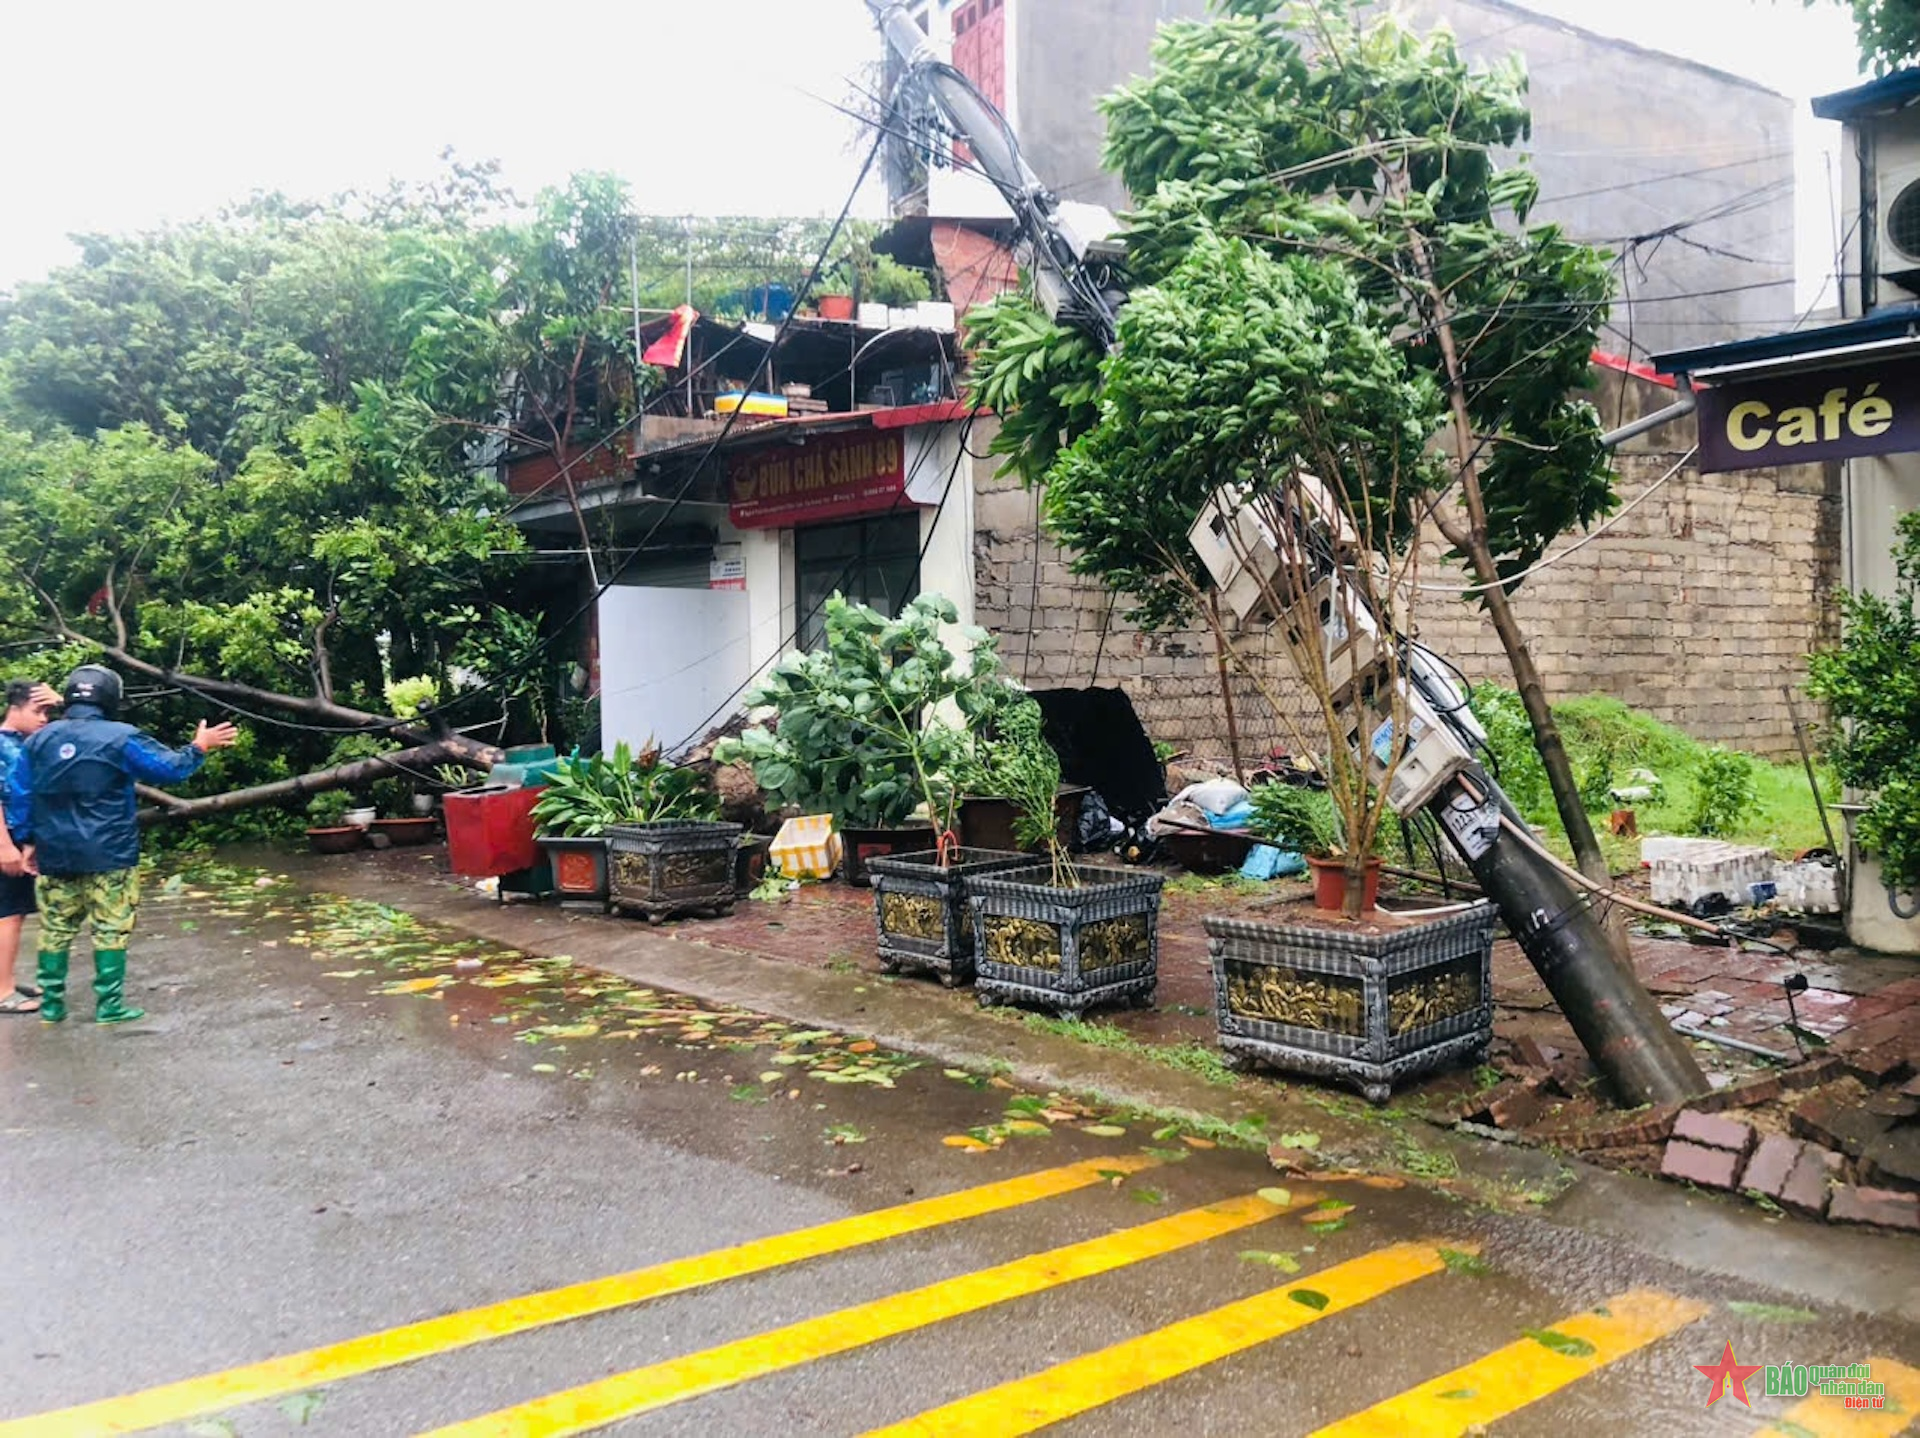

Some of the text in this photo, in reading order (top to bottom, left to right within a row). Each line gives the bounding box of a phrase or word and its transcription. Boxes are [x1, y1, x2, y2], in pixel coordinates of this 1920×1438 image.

[1726, 383, 1893, 451] Café
[760, 454, 789, 497] BÚN
[876, 437, 898, 476] 89
